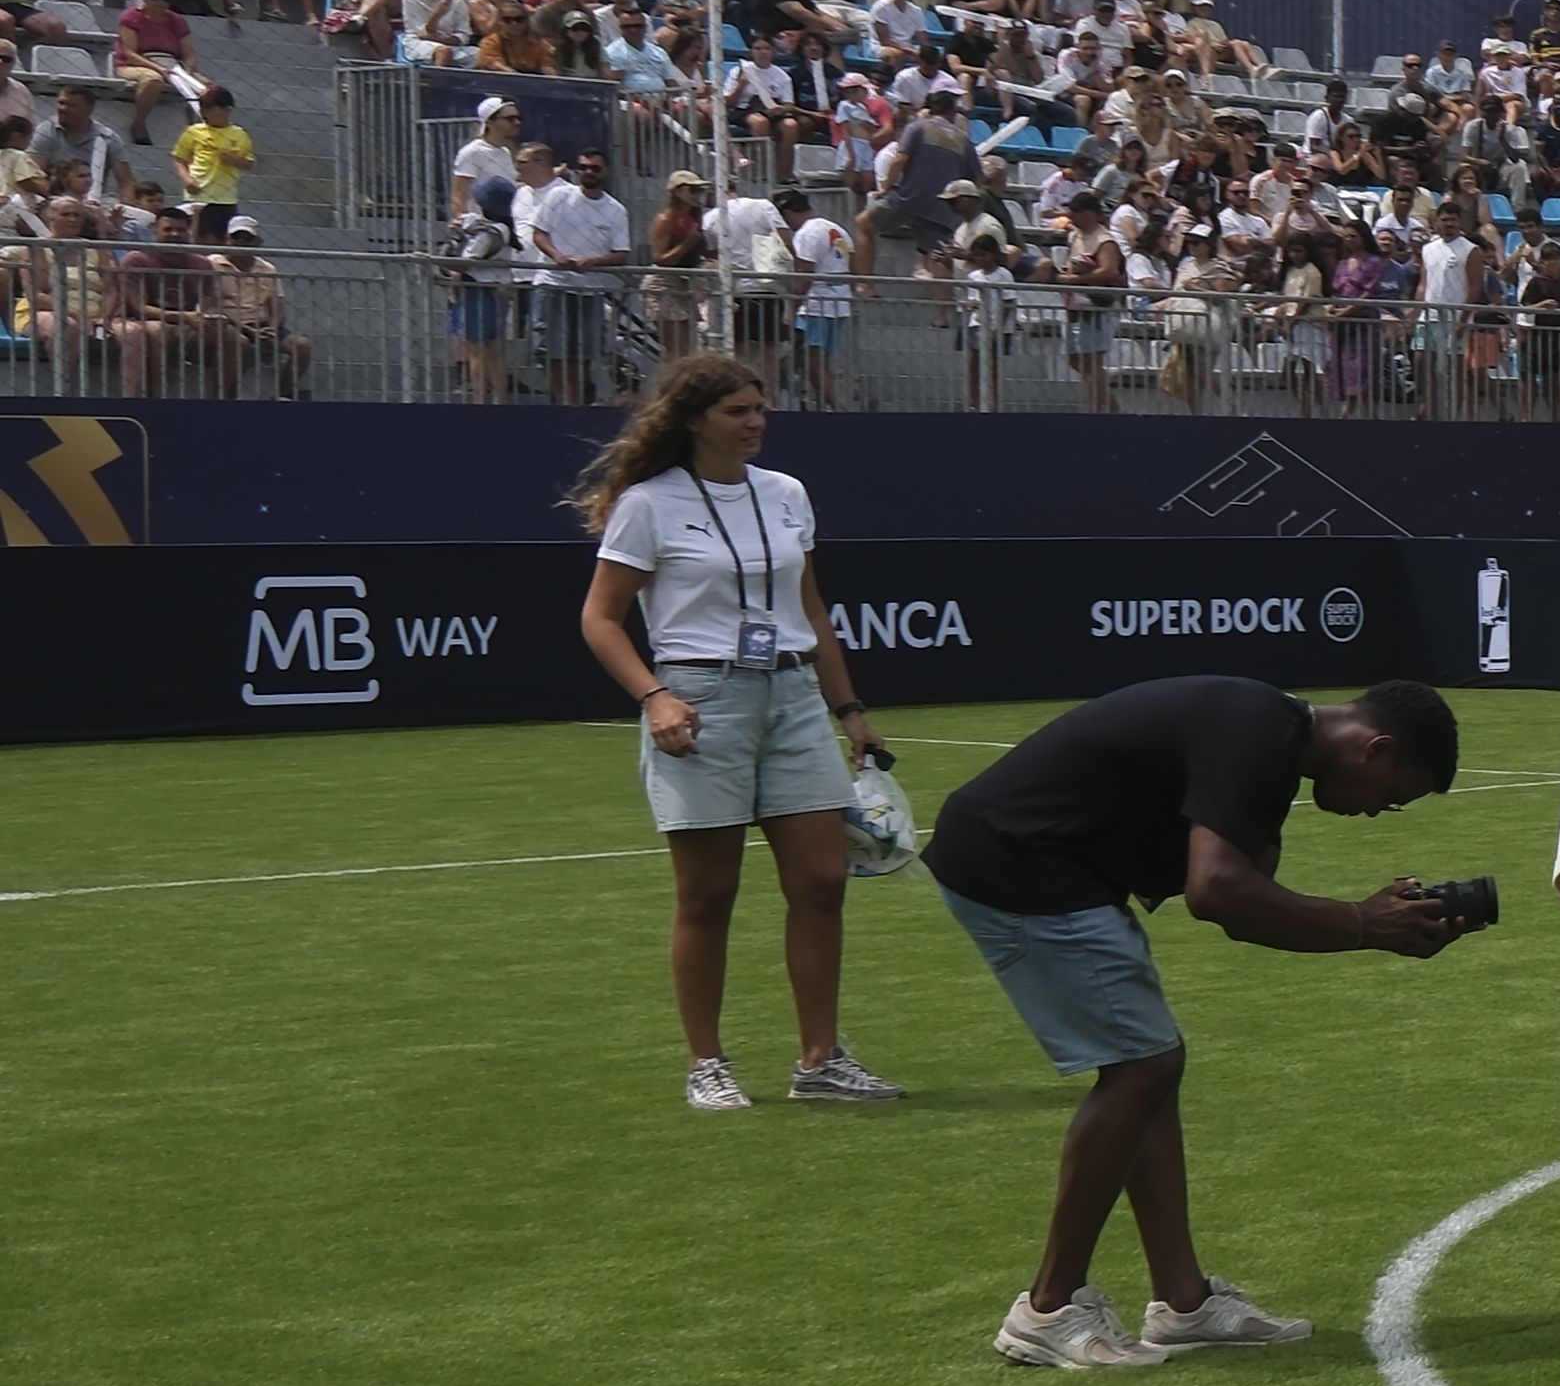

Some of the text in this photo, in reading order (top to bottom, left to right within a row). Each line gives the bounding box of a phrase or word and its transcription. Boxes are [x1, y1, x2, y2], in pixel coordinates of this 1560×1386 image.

[829, 600, 972, 649] ANCA
[1091, 596, 1305, 638] SUPER BOCK
[1326, 603, 1358, 616] SUPER
[245, 608, 498, 672] MB WAY
